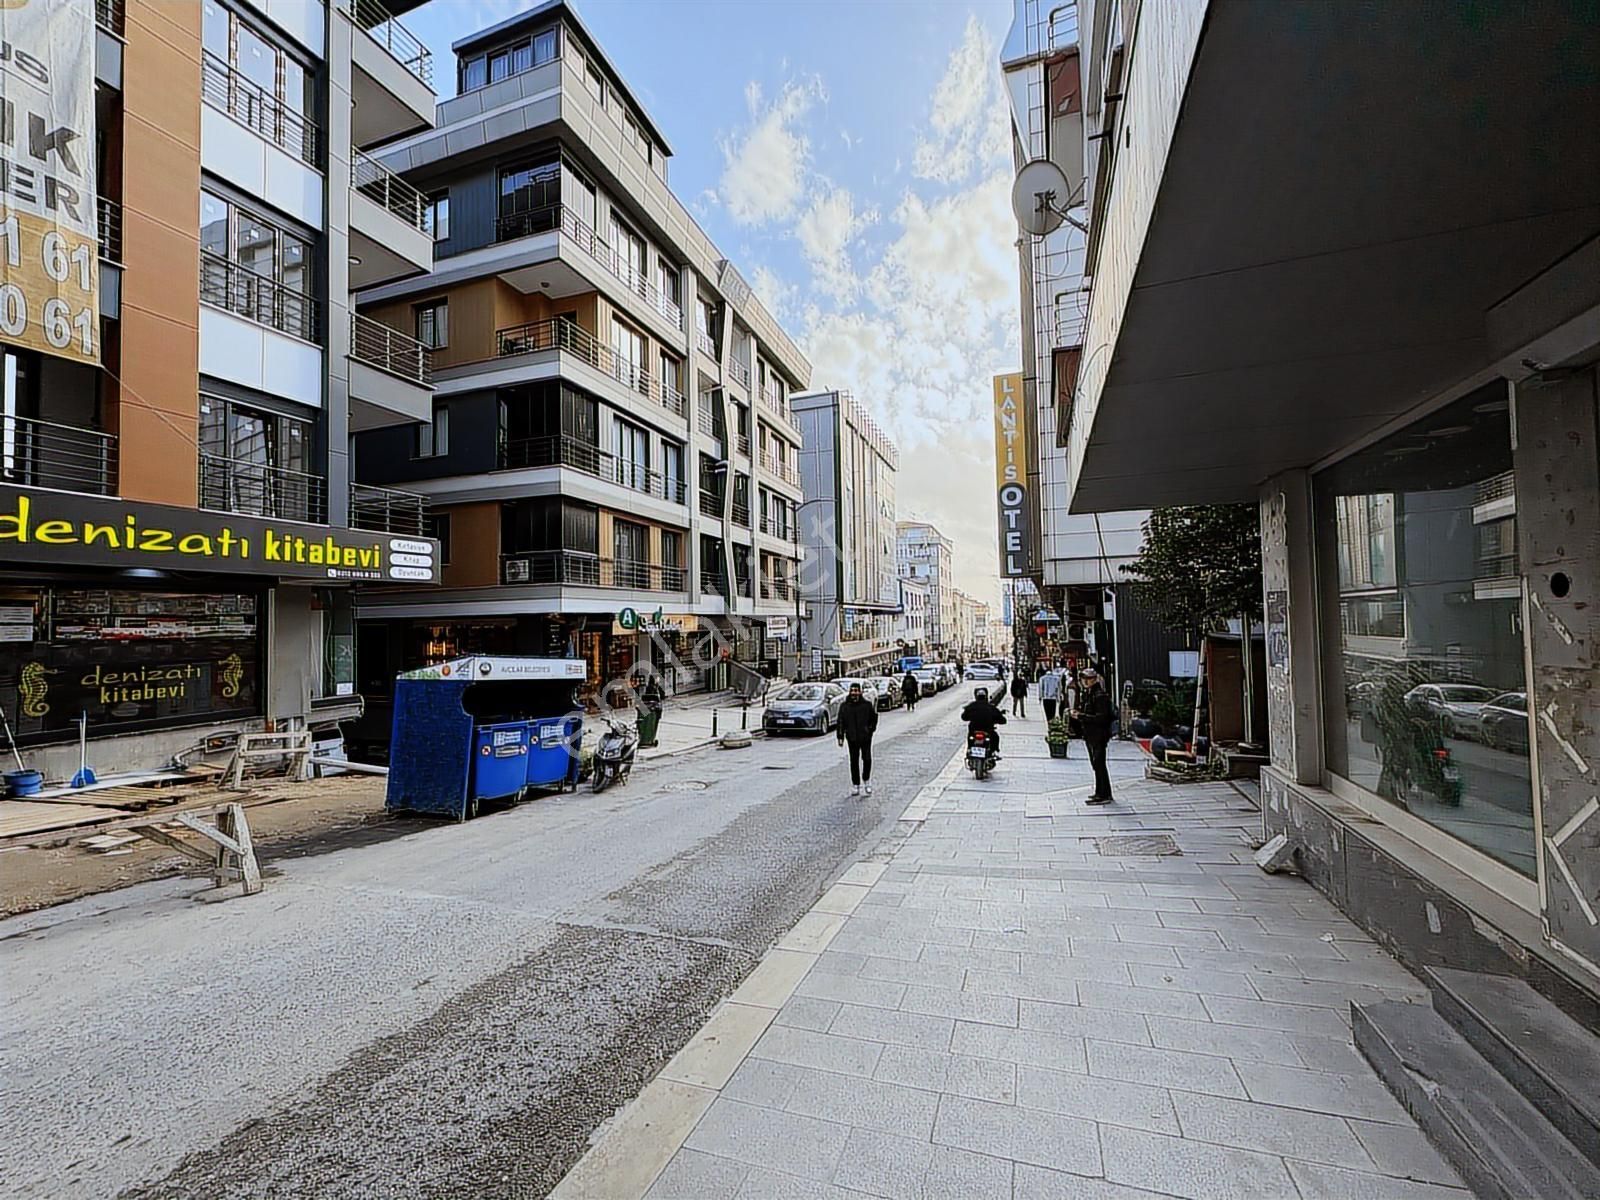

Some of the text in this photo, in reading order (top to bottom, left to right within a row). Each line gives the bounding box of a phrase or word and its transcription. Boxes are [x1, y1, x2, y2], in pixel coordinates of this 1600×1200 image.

[42, 230, 92, 293] 61
[43, 297, 93, 356] 61
[0, 496, 381, 568] denizatı kitabevi
[1001, 486, 1023, 576] OTEL
[81, 664, 201, 686] denizatı
[100, 682, 185, 704] kitabevi
